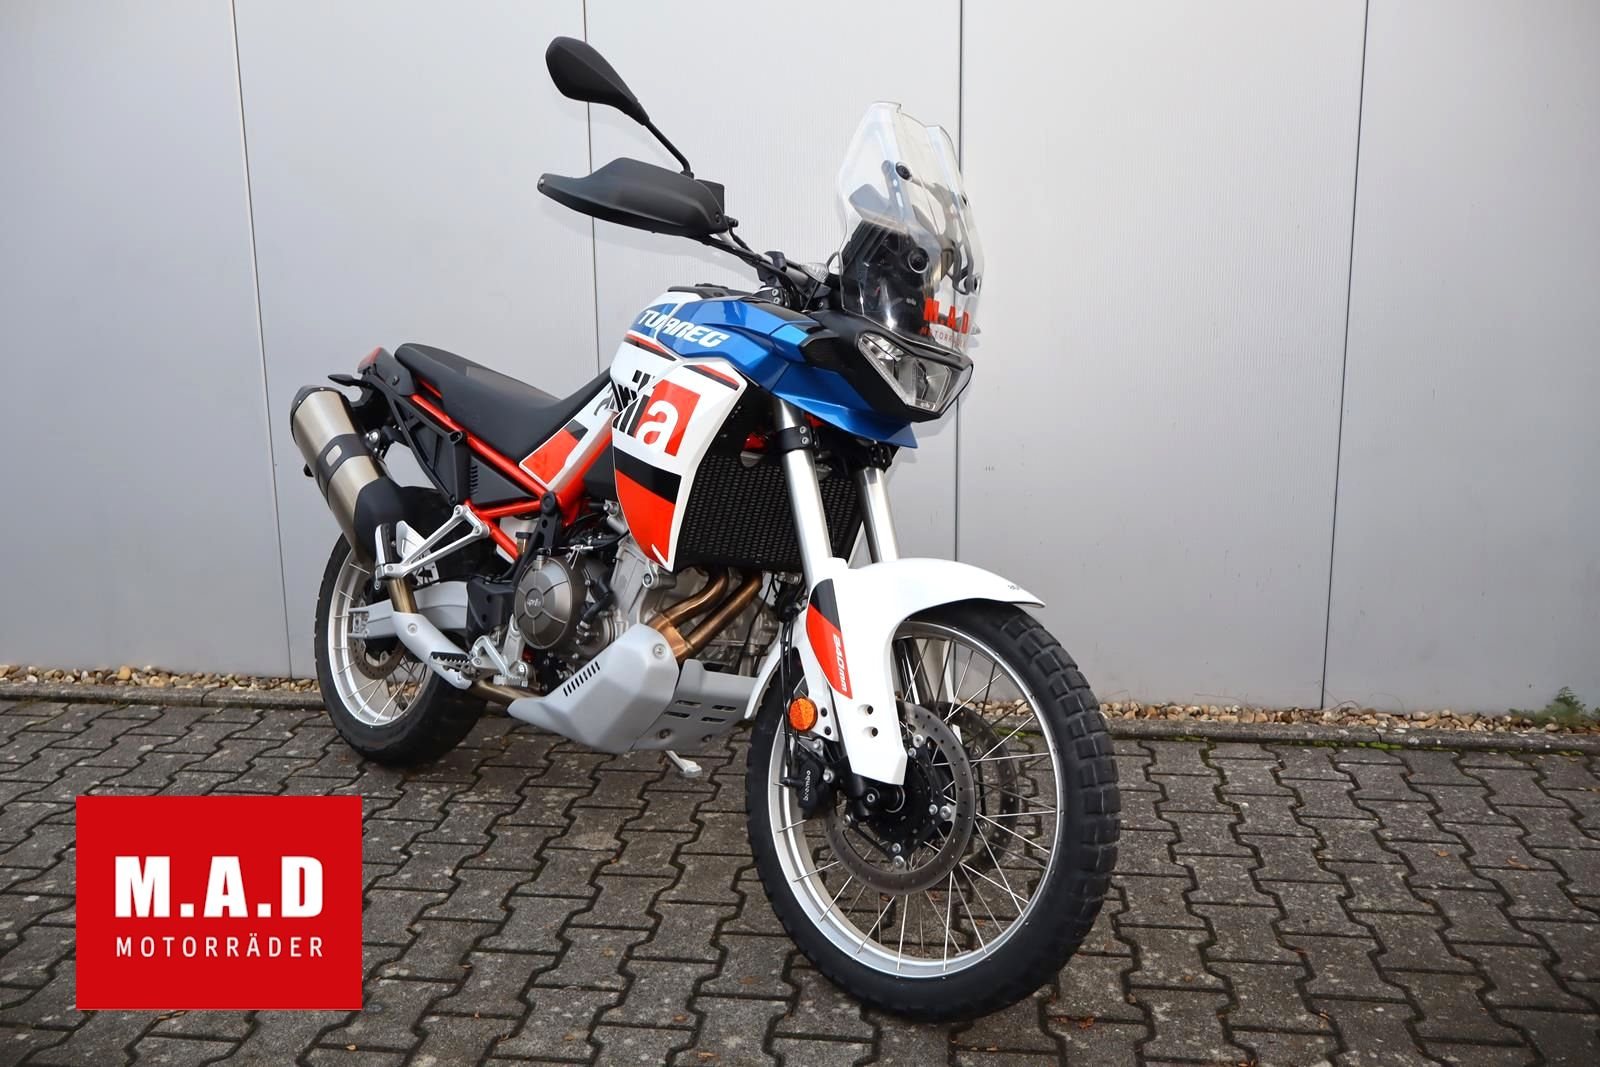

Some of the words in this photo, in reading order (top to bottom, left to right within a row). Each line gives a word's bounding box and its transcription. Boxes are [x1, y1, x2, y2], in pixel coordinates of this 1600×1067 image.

[638, 309, 731, 348] TUAREG
[924, 296, 969, 335] M.A.D
[803, 769, 812, 802] brembo
